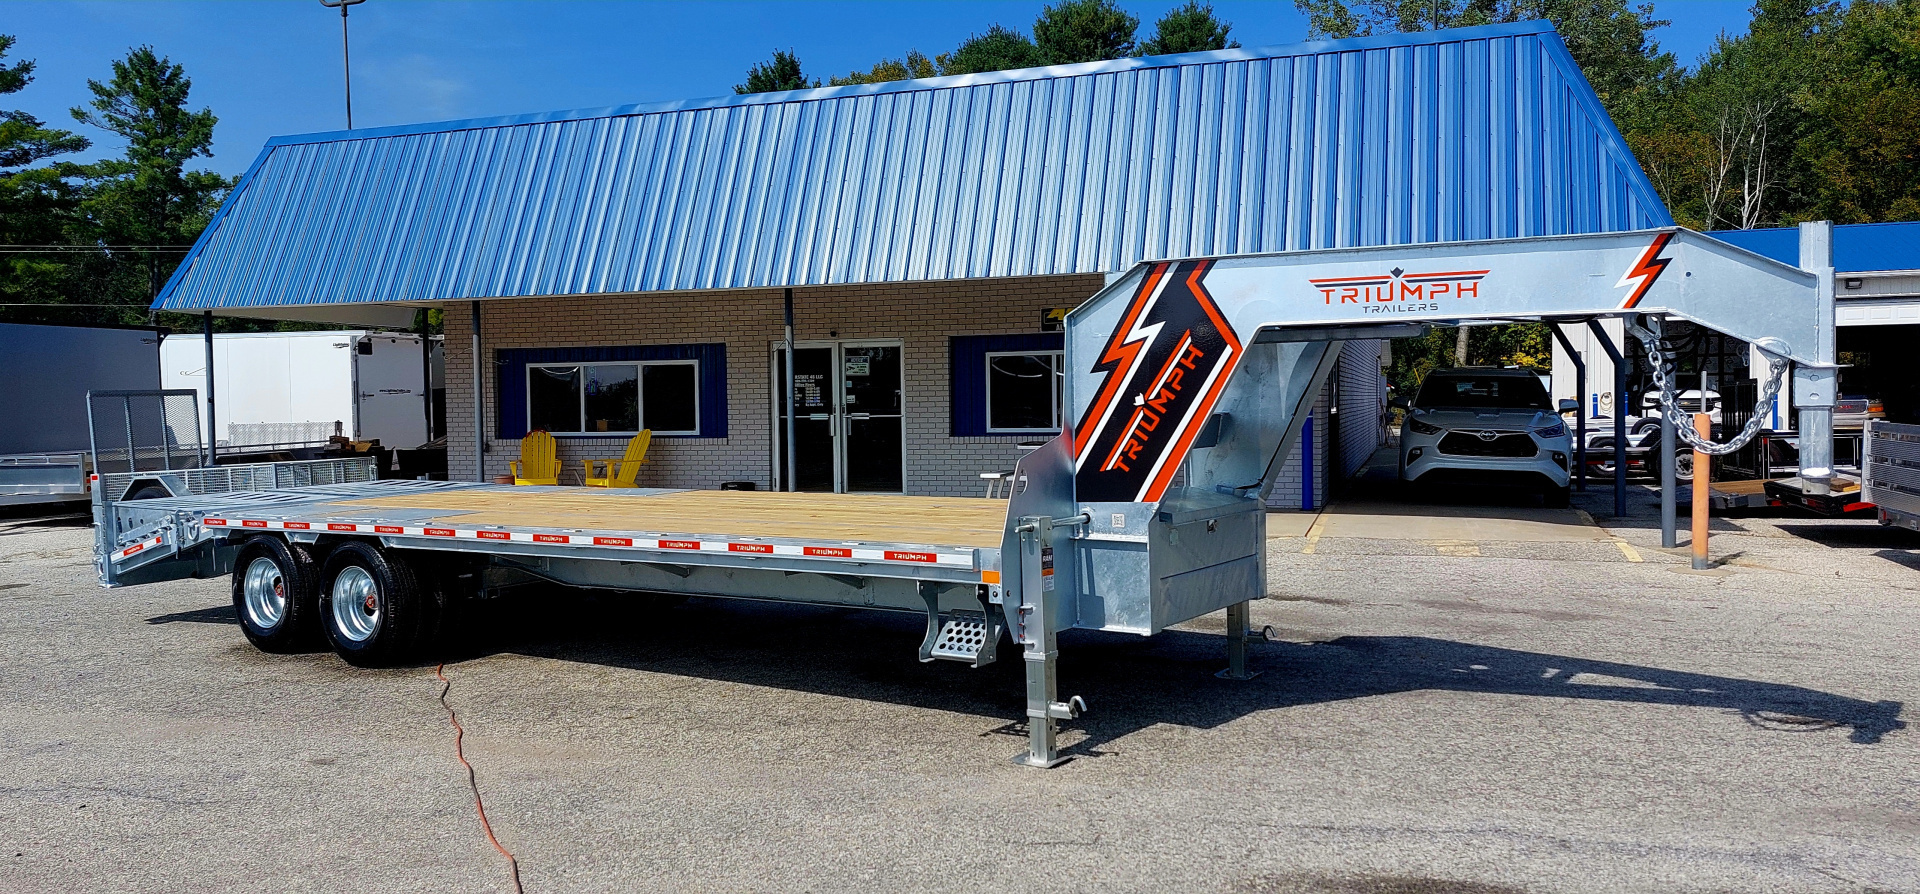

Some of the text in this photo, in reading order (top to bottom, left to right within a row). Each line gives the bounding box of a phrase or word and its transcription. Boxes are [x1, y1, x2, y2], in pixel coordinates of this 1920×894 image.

[1319, 280, 1479, 304] TRIUMPH
[1362, 302, 1438, 313] TRAILERS
[1113, 343, 1204, 472] TRIUMPH
[600, 538, 626, 546] TRIUMPH
[666, 541, 693, 549] TRIUMPH
[812, 548, 843, 556] TRIUMPH
[893, 553, 927, 561] TRIUMPH
